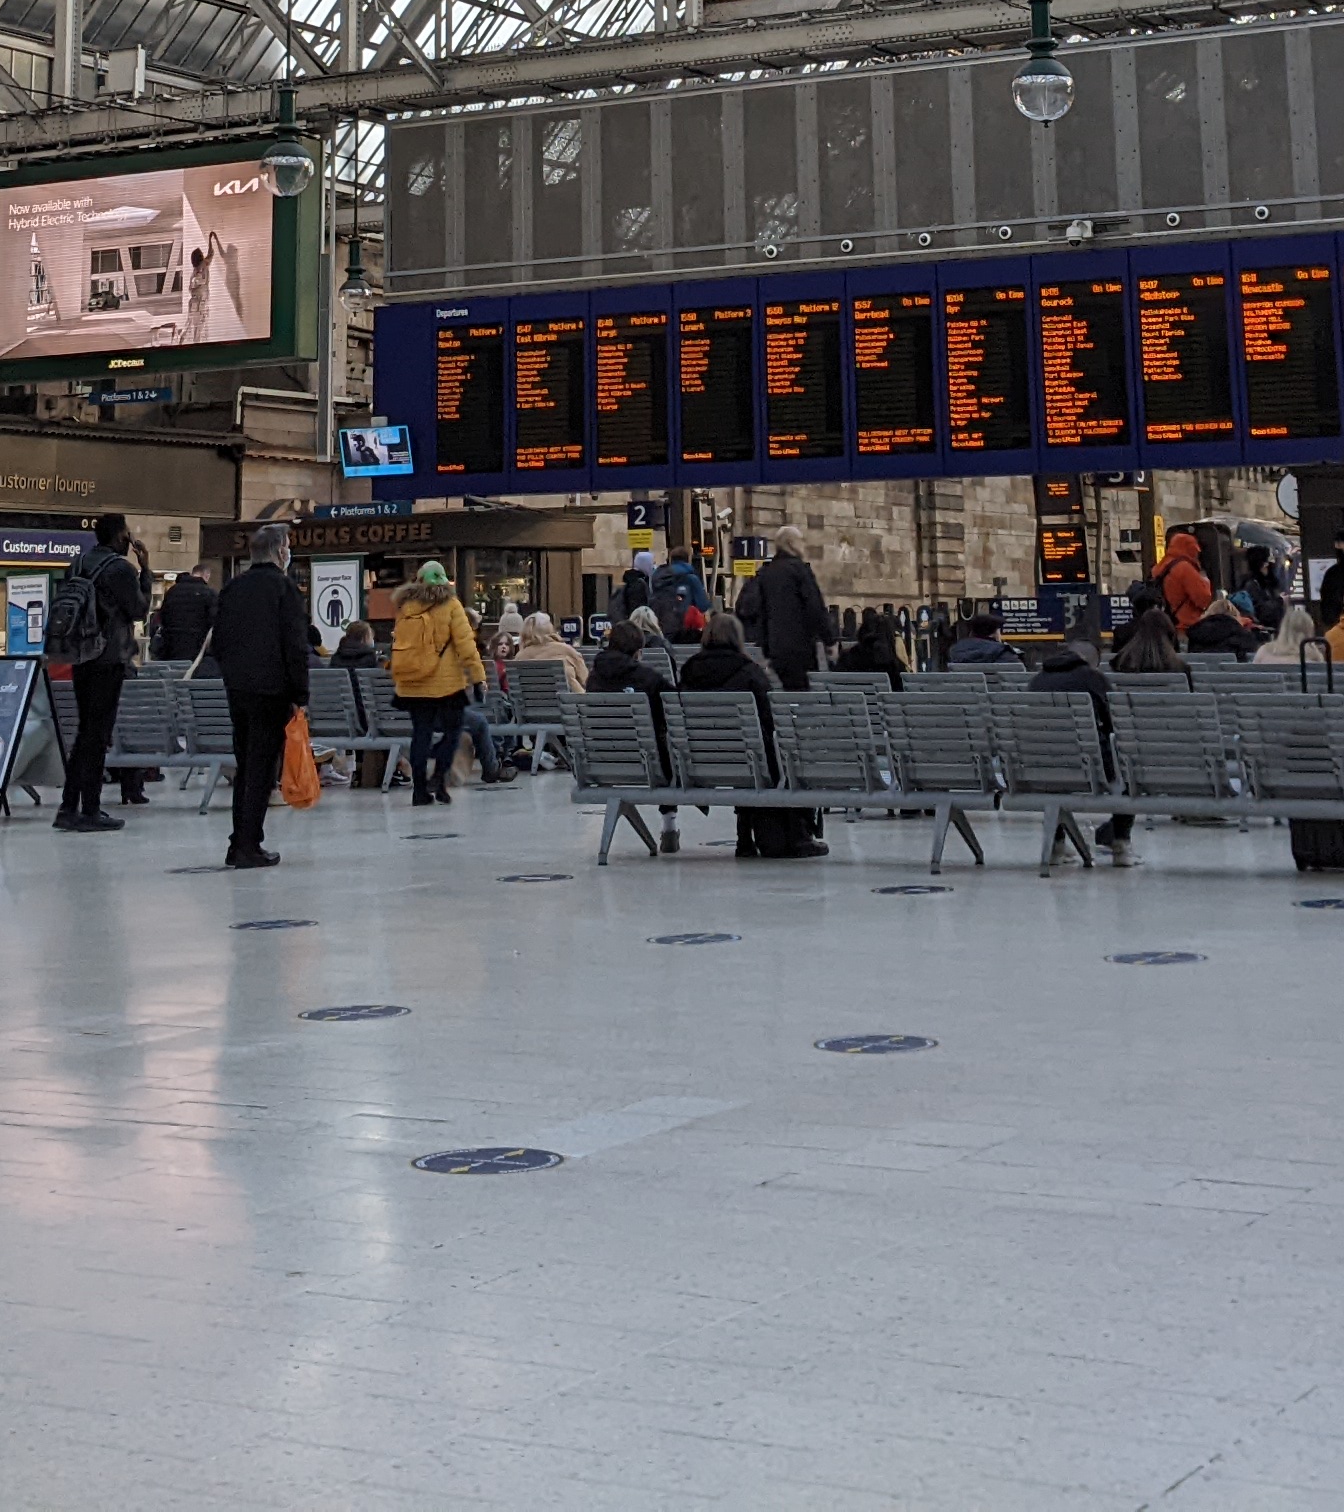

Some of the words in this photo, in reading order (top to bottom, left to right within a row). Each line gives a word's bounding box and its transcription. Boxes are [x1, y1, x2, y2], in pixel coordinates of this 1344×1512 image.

[9, 203, 30, 215] Now
[32, 200, 71, 212] available
[73, 196, 93, 208] with
[8, 217, 39, 230] Hybrid
[41, 213, 74, 226] Electric
[436, 308, 468, 318] Departures
[800, 304, 830, 313] Platform
[132, 391, 136, 399] 1
[137, 390, 144, 399] &
[144, 390, 150, 399] 2
[55, 474, 95, 496] lounge
[341, 507, 375, 516] Platforms
[378, 505, 381, 514] 1
[384, 505, 390, 514] &
[391, 504, 397, 513] 2
[634, 505, 646, 525] 2
[356, 523, 432, 543] COFFEE
[3, 540, 47, 553] Customer
[48, 541, 81, 556] Lounge
[742, 540, 748, 555] 1
[759, 540, 764, 556] 1
[0, 683, 19, 693] safer
